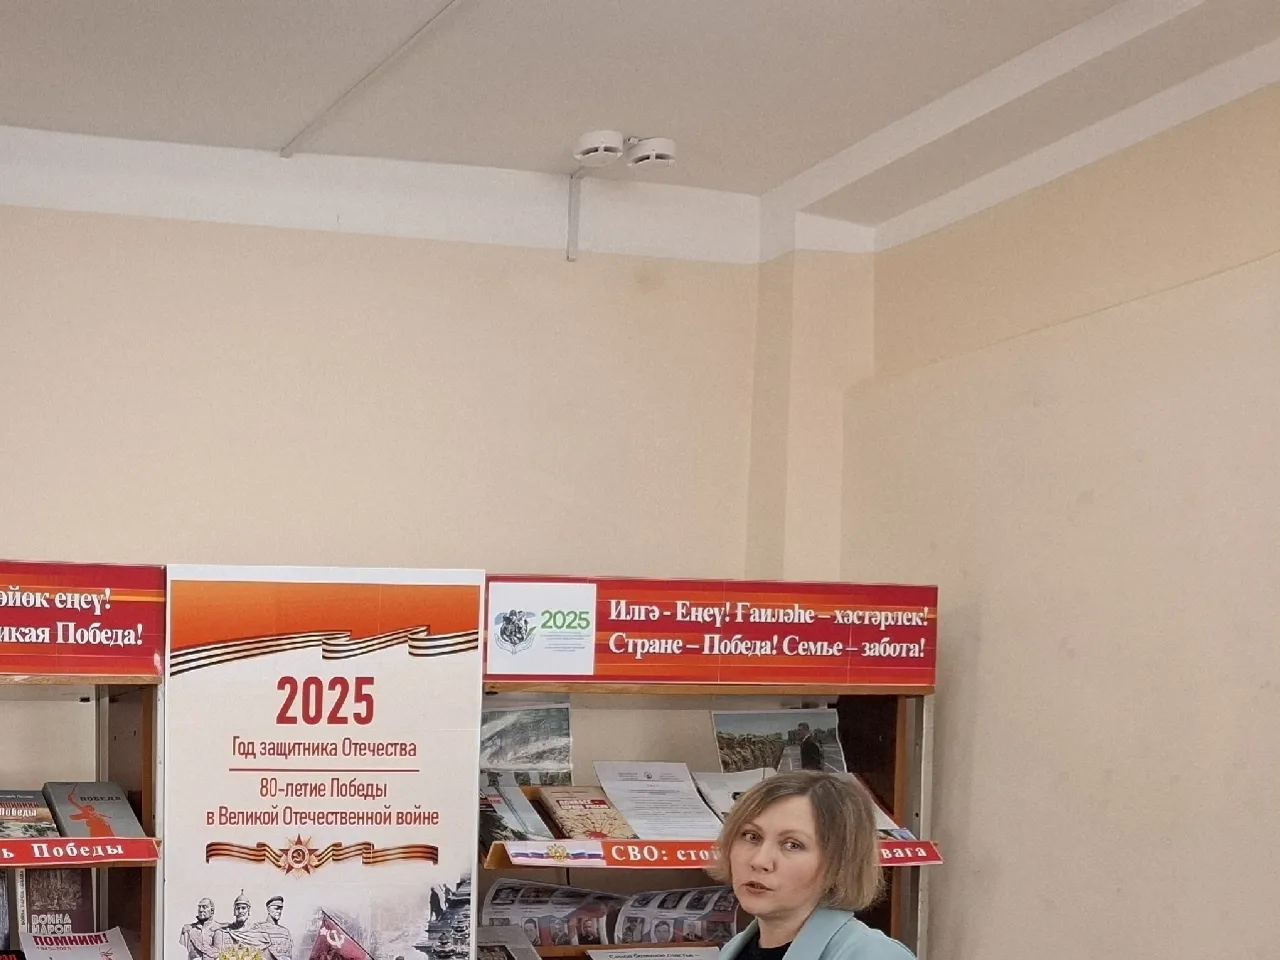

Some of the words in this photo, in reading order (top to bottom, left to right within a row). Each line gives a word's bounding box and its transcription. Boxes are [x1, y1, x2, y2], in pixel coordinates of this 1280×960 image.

[54, 587, 112, 616] еңеү!
[540, 609, 591, 631] 2025
[609, 599, 660, 623] Илгә
[675, 601, 731, 630] Еңеү!
[735, 602, 815, 625] Ғаиләһе
[833, 606, 929, 630] хәстәрлек!
[55, 620, 144, 648] Победа!
[608, 632, 684, 660] Стране
[703, 634, 778, 658] Победа!
[782, 635, 843, 658] Семье
[861, 637, 926, 659] забота!
[275, 675, 375, 726] 2025
[232, 735, 257, 760] Год
[259, 740, 338, 760] защитника
[341, 737, 417, 758] Отечества
[259, 777, 326, 798] 80-летие
[330, 777, 388, 801] Победы
[206, 811, 215, 826] в
[218, 804, 279, 826] Великой
[283, 804, 392, 827] Отечественной
[396, 804, 440, 826] войне
[31, 841, 125, 861] Победы
[611, 844, 668, 862] СВО:
[881, 846, 927, 860] вага
[31, 912, 72, 924] ВОЙНА
[32, 924, 72, 934] НАРОД
[32, 933, 110, 946] ПОМНИМ!
